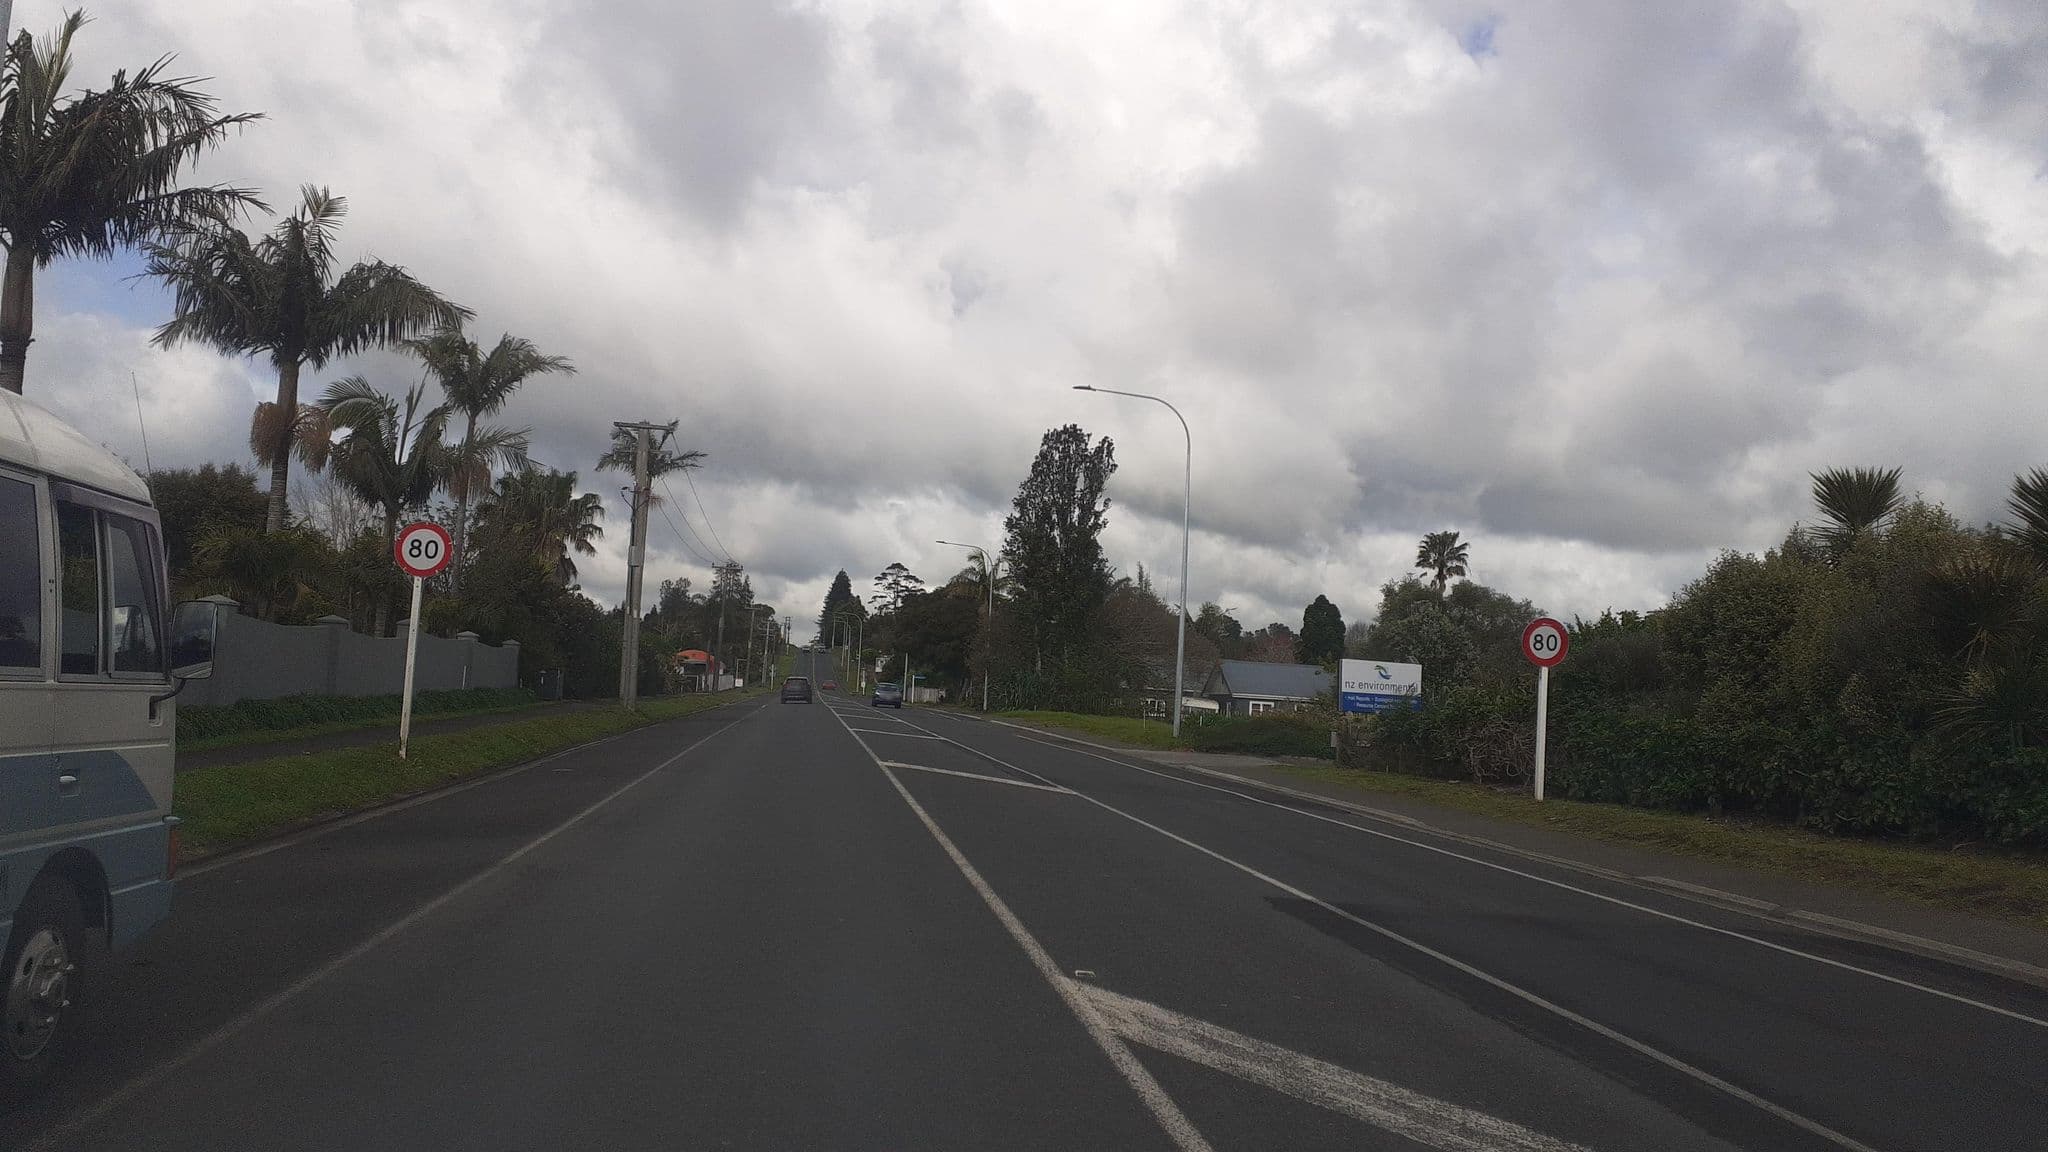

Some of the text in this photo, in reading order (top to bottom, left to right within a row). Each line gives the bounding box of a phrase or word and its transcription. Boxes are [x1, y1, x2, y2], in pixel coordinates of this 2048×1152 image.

[409, 539, 438, 559] 80
[1533, 634, 1557, 651] 80
[1344, 680, 1356, 688] nz
